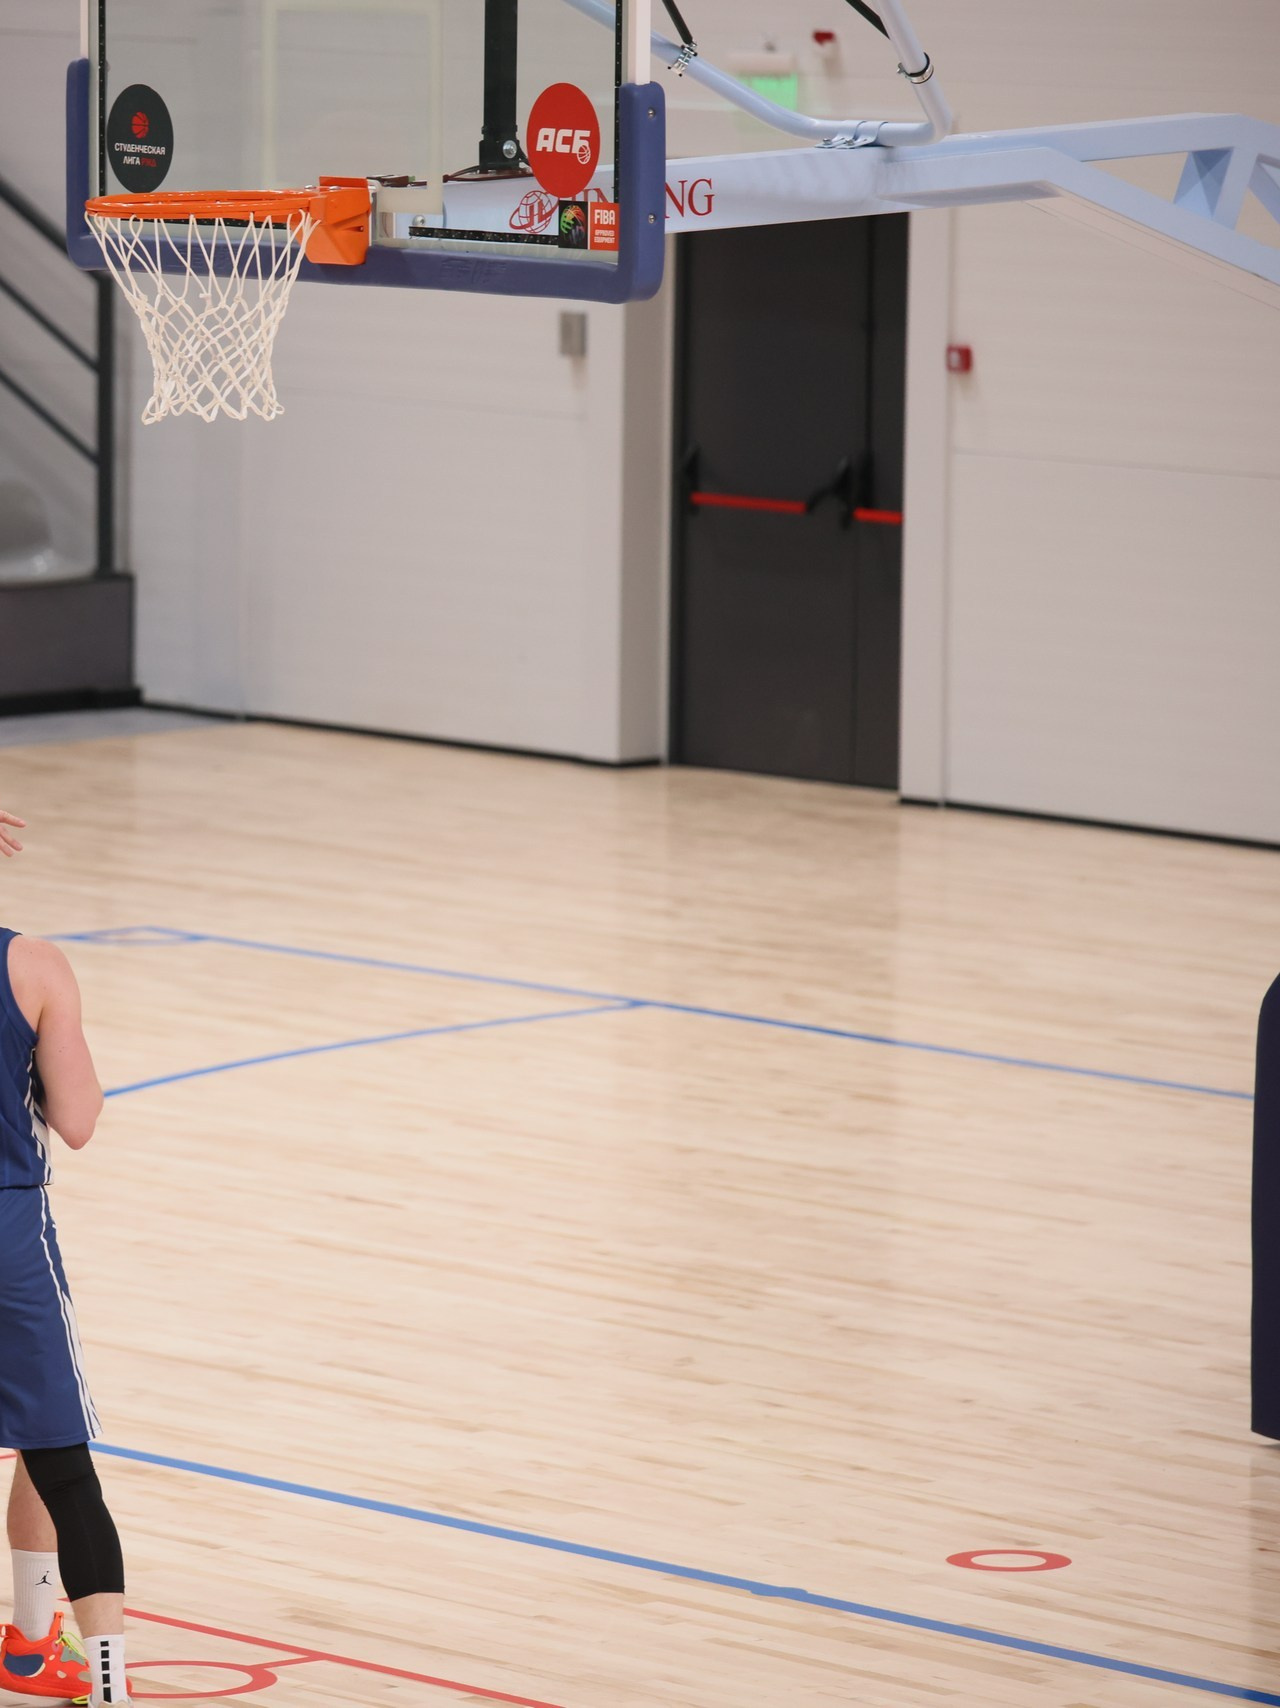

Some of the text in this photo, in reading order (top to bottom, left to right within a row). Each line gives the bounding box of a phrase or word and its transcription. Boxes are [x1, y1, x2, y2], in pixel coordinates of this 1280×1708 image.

[114, 142, 166, 155] СТУДЕНЧЕСКАЯ
[122, 156, 141, 166] ЛИГА
[594, 208, 616, 226] FIBA
